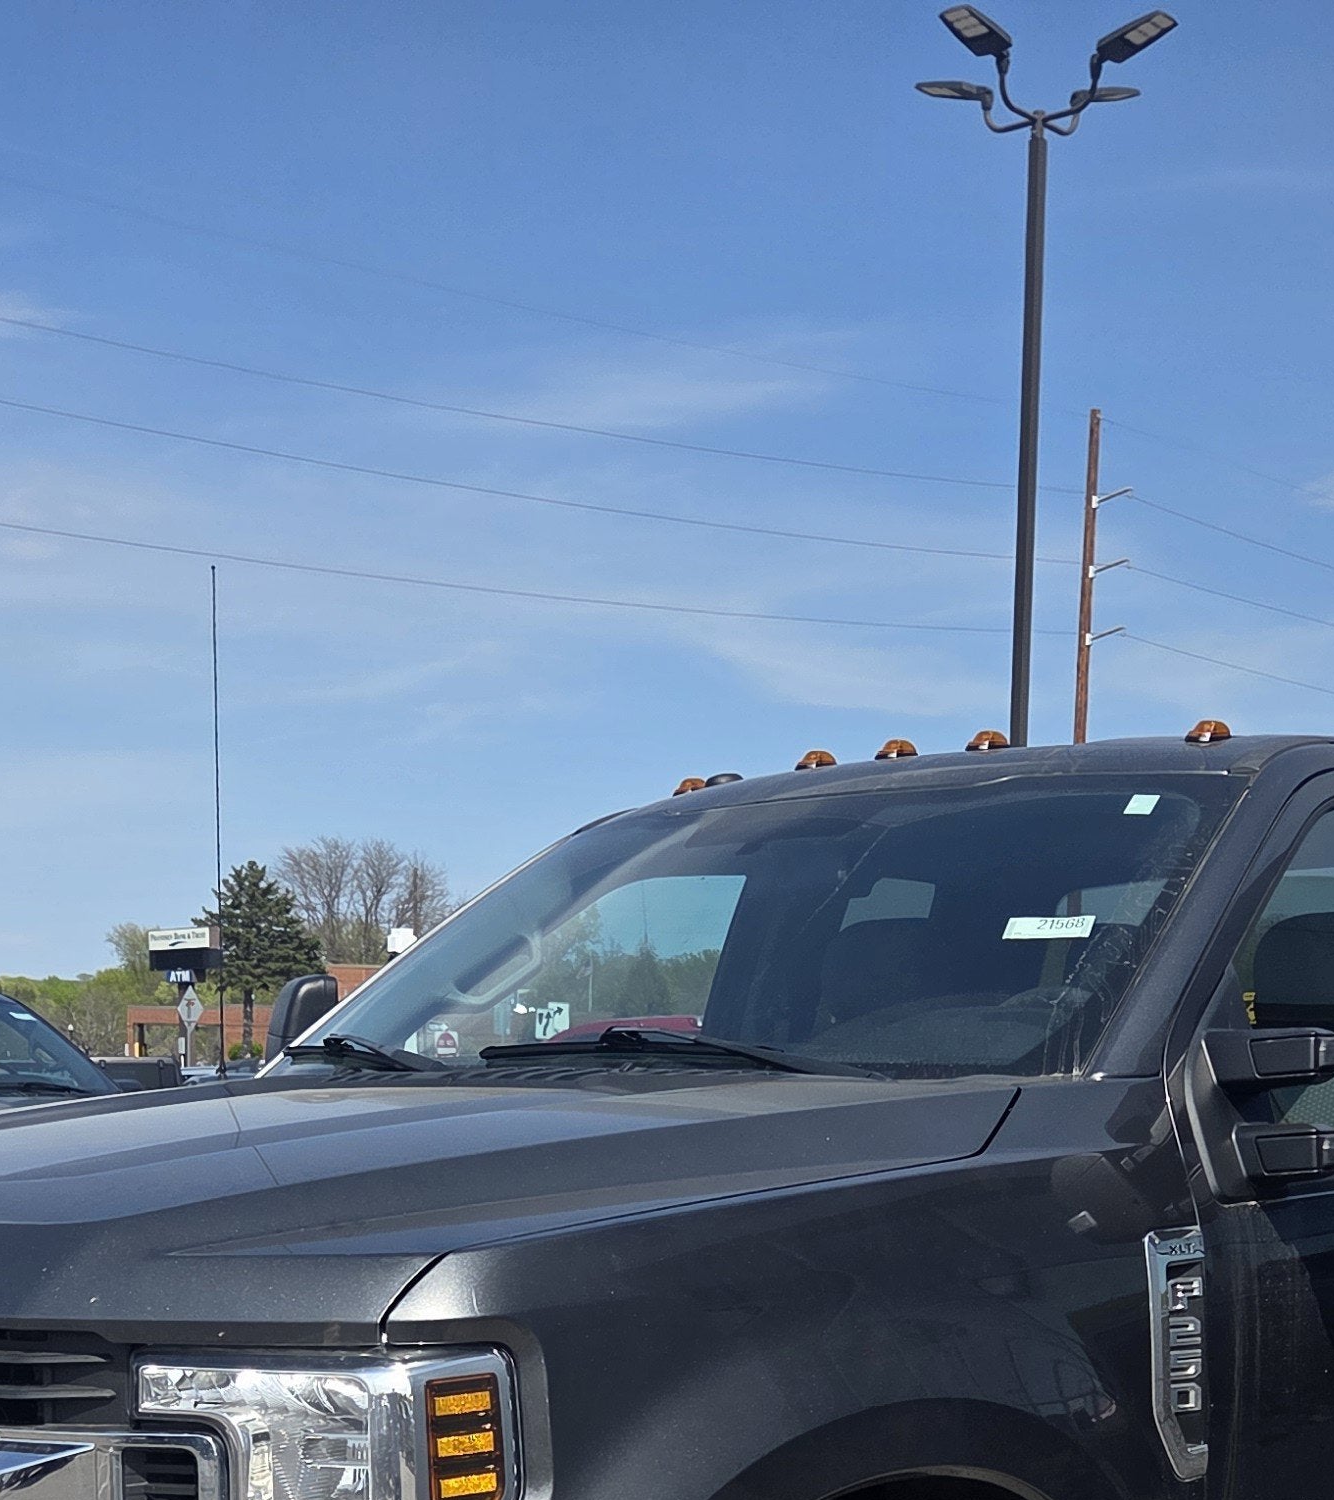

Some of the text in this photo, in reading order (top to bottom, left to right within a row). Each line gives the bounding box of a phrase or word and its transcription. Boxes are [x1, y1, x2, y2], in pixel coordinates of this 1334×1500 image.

[1037, 918, 1085, 930] 21568
[169, 970, 190, 982] ATM
[1169, 1242, 1196, 1255] XLT
